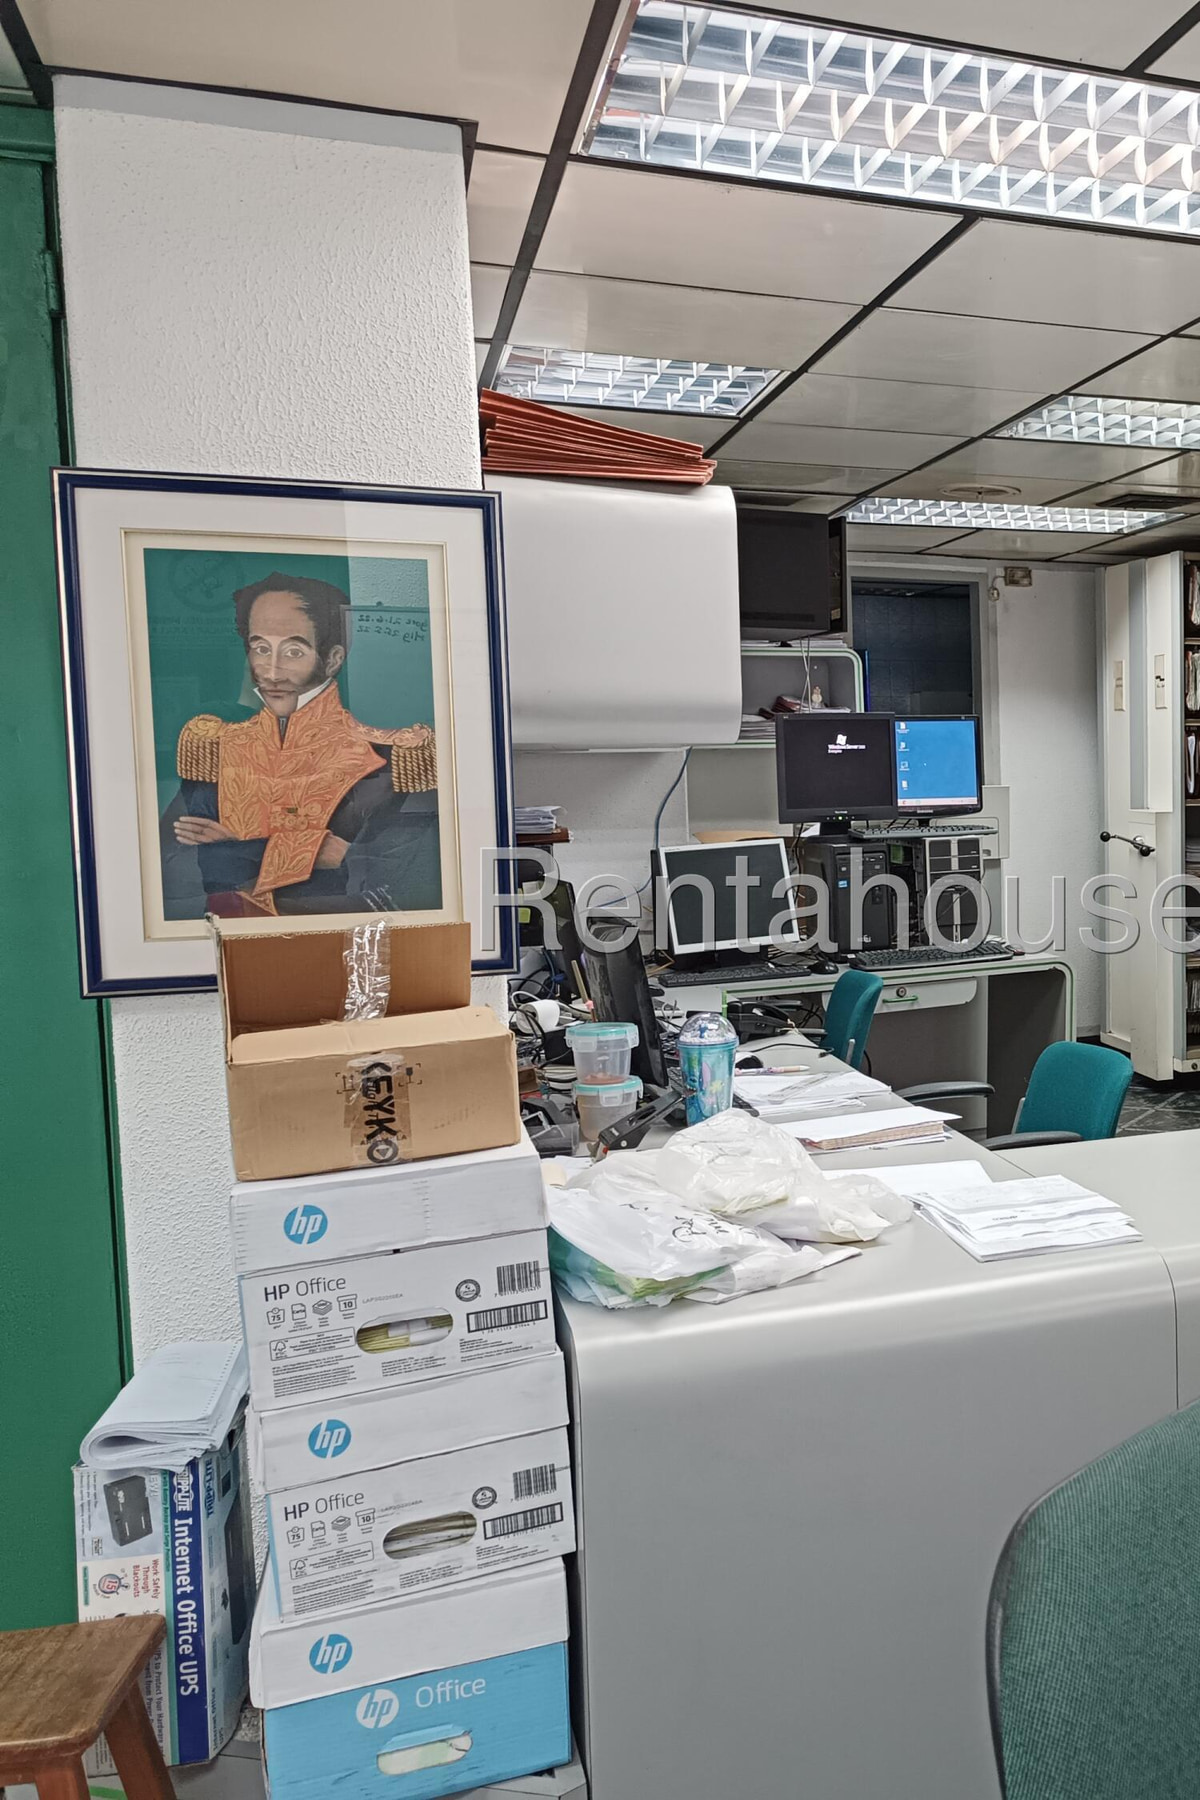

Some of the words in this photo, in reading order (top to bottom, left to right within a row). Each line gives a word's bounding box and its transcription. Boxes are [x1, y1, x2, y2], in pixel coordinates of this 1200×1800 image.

[284, 1204, 328, 1245] hp
[264, 1283, 290, 1302] HP
[295, 1277, 346, 1297] Office
[271, 1314, 281, 1322] 75
[343, 1301, 353, 1309] 10
[308, 1419, 352, 1459] hp
[284, 1502, 309, 1522] HP
[315, 1492, 364, 1514] Office
[361, 1515, 372, 1523] 10
[291, 1533, 301, 1541] 75
[152, 1558, 160, 1577] Work
[174, 1517, 194, 1595] Internet
[106, 1580, 118, 1591] 15
[132, 1565, 140, 1598] Blackouts
[142, 1566, 150, 1594] Through
[152, 1578, 161, 1599] Safely
[309, 1633, 353, 1674] hp
[179, 1661, 199, 1696] UPS
[356, 1689, 400, 1729] hp
[415, 1678, 486, 1709] Office
[157, 1713, 165, 1743] Hardware
